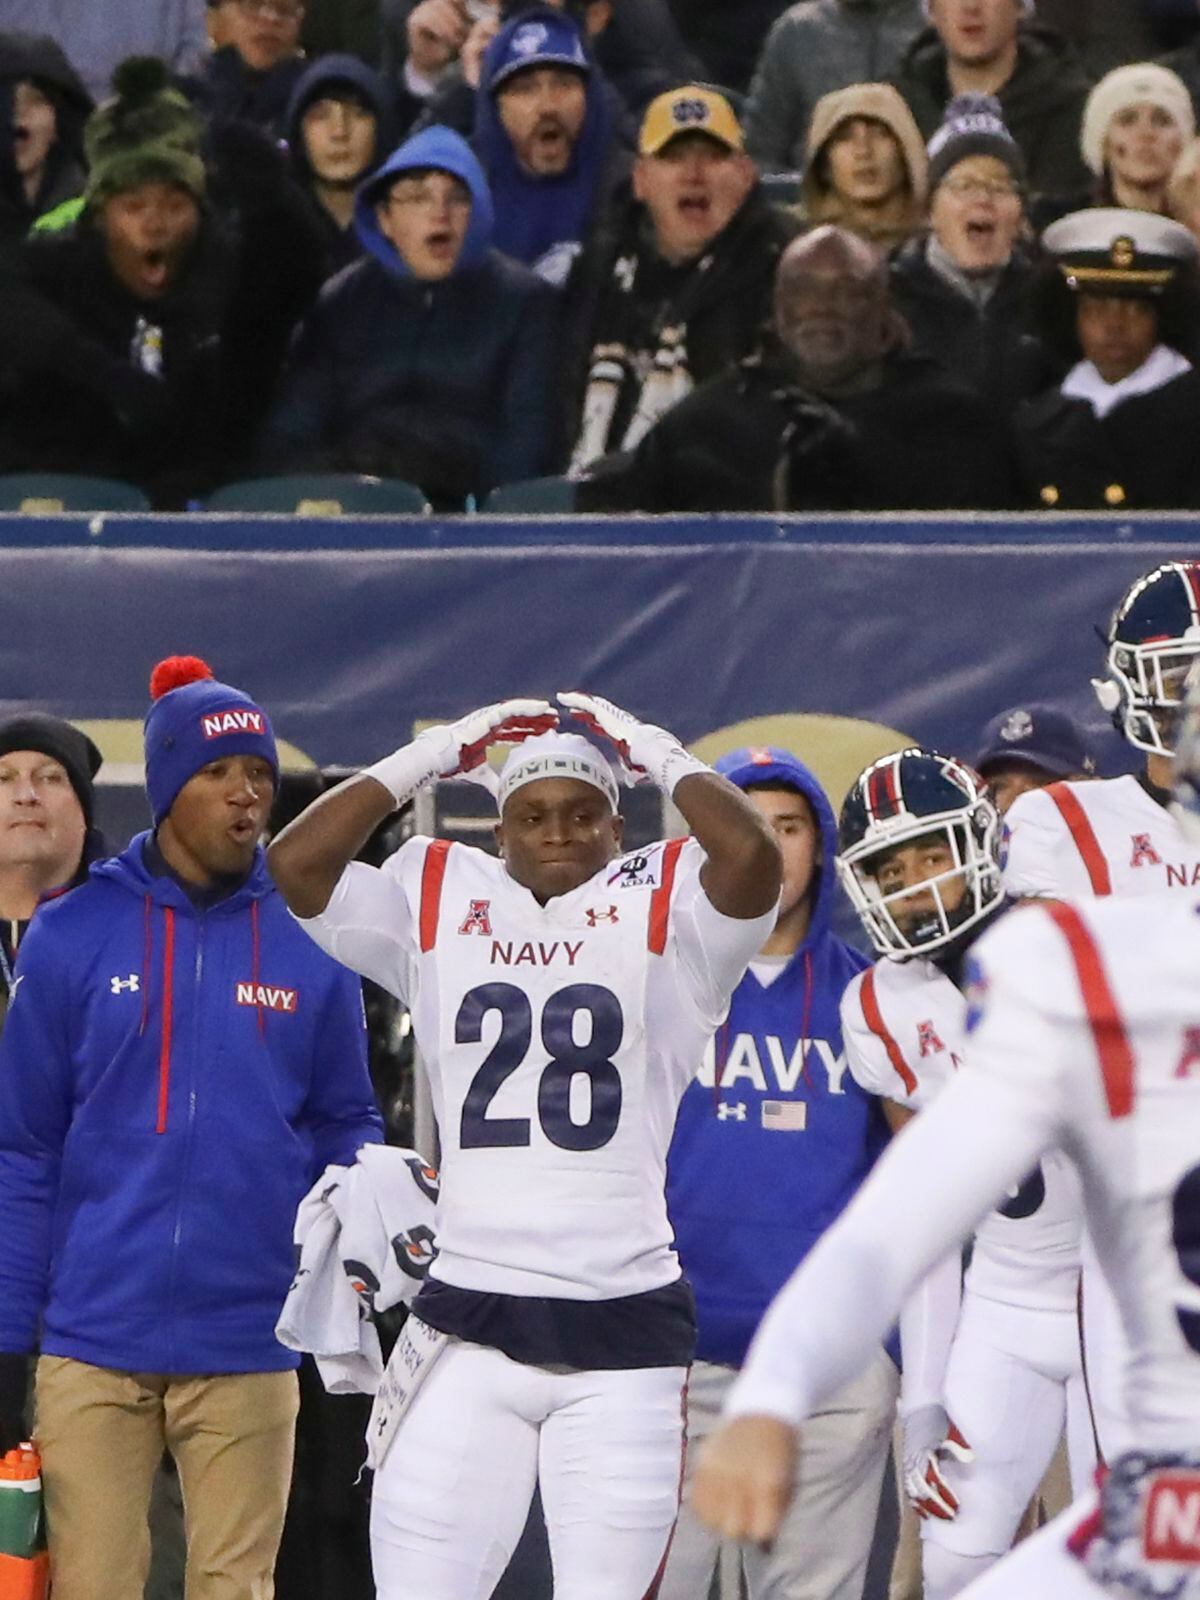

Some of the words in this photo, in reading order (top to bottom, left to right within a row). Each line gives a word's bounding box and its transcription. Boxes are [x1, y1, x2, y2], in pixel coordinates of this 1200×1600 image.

[203, 711, 261, 737] NAVY
[458, 899, 493, 936] A
[489, 940, 585, 966] NAVY
[237, 983, 295, 1011] NAVY
[454, 981, 624, 1151] 28
